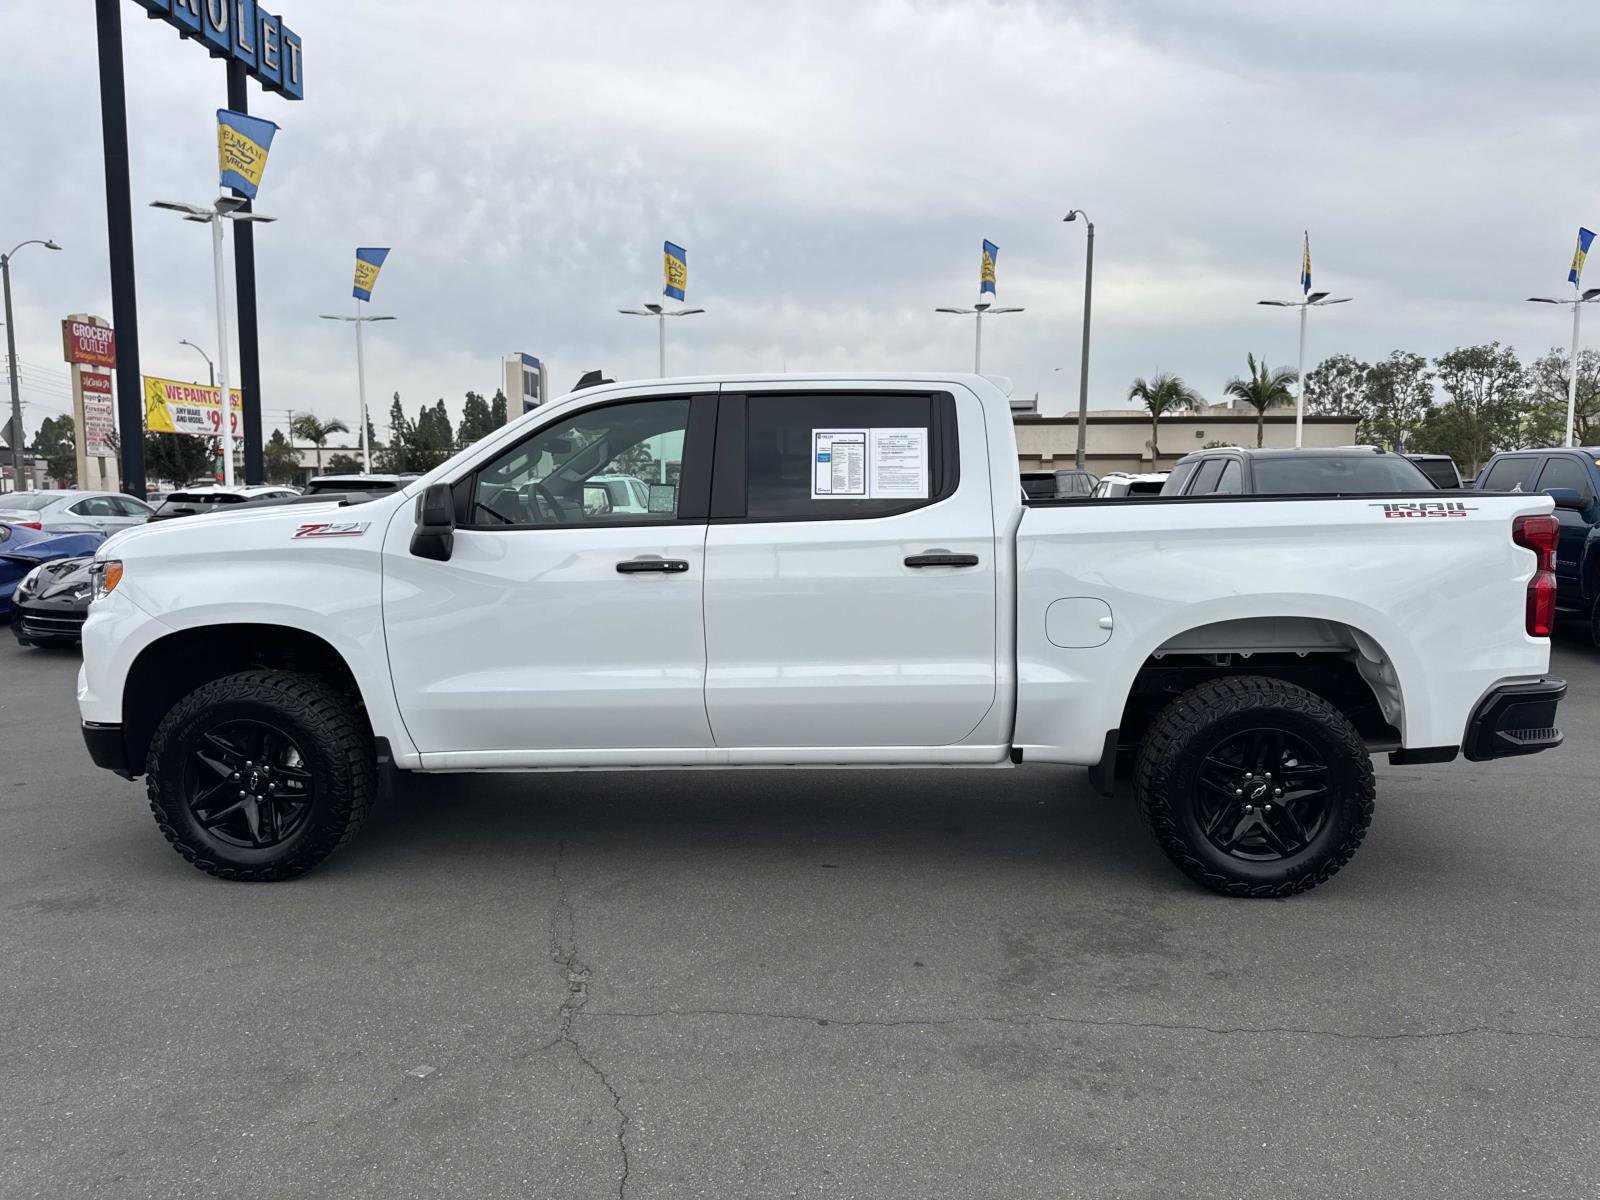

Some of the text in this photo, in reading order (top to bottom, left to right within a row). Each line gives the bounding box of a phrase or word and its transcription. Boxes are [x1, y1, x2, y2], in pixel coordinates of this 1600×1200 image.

[222, 130, 262, 160] ELMAN
[72, 322, 113, 343] GROCERY
[80, 337, 109, 354] OUTLET
[165, 384, 184, 401] WE
[184, 387, 212, 404] PAINT
[176, 407, 201, 417] ANY MAKE
[176, 415, 204, 425] AND MODEL
[207, 410, 238, 433] $99
[1368, 502, 1479, 512] TRAIL
[1384, 510, 1467, 518] BOSS
[293, 522, 371, 538] Z71
